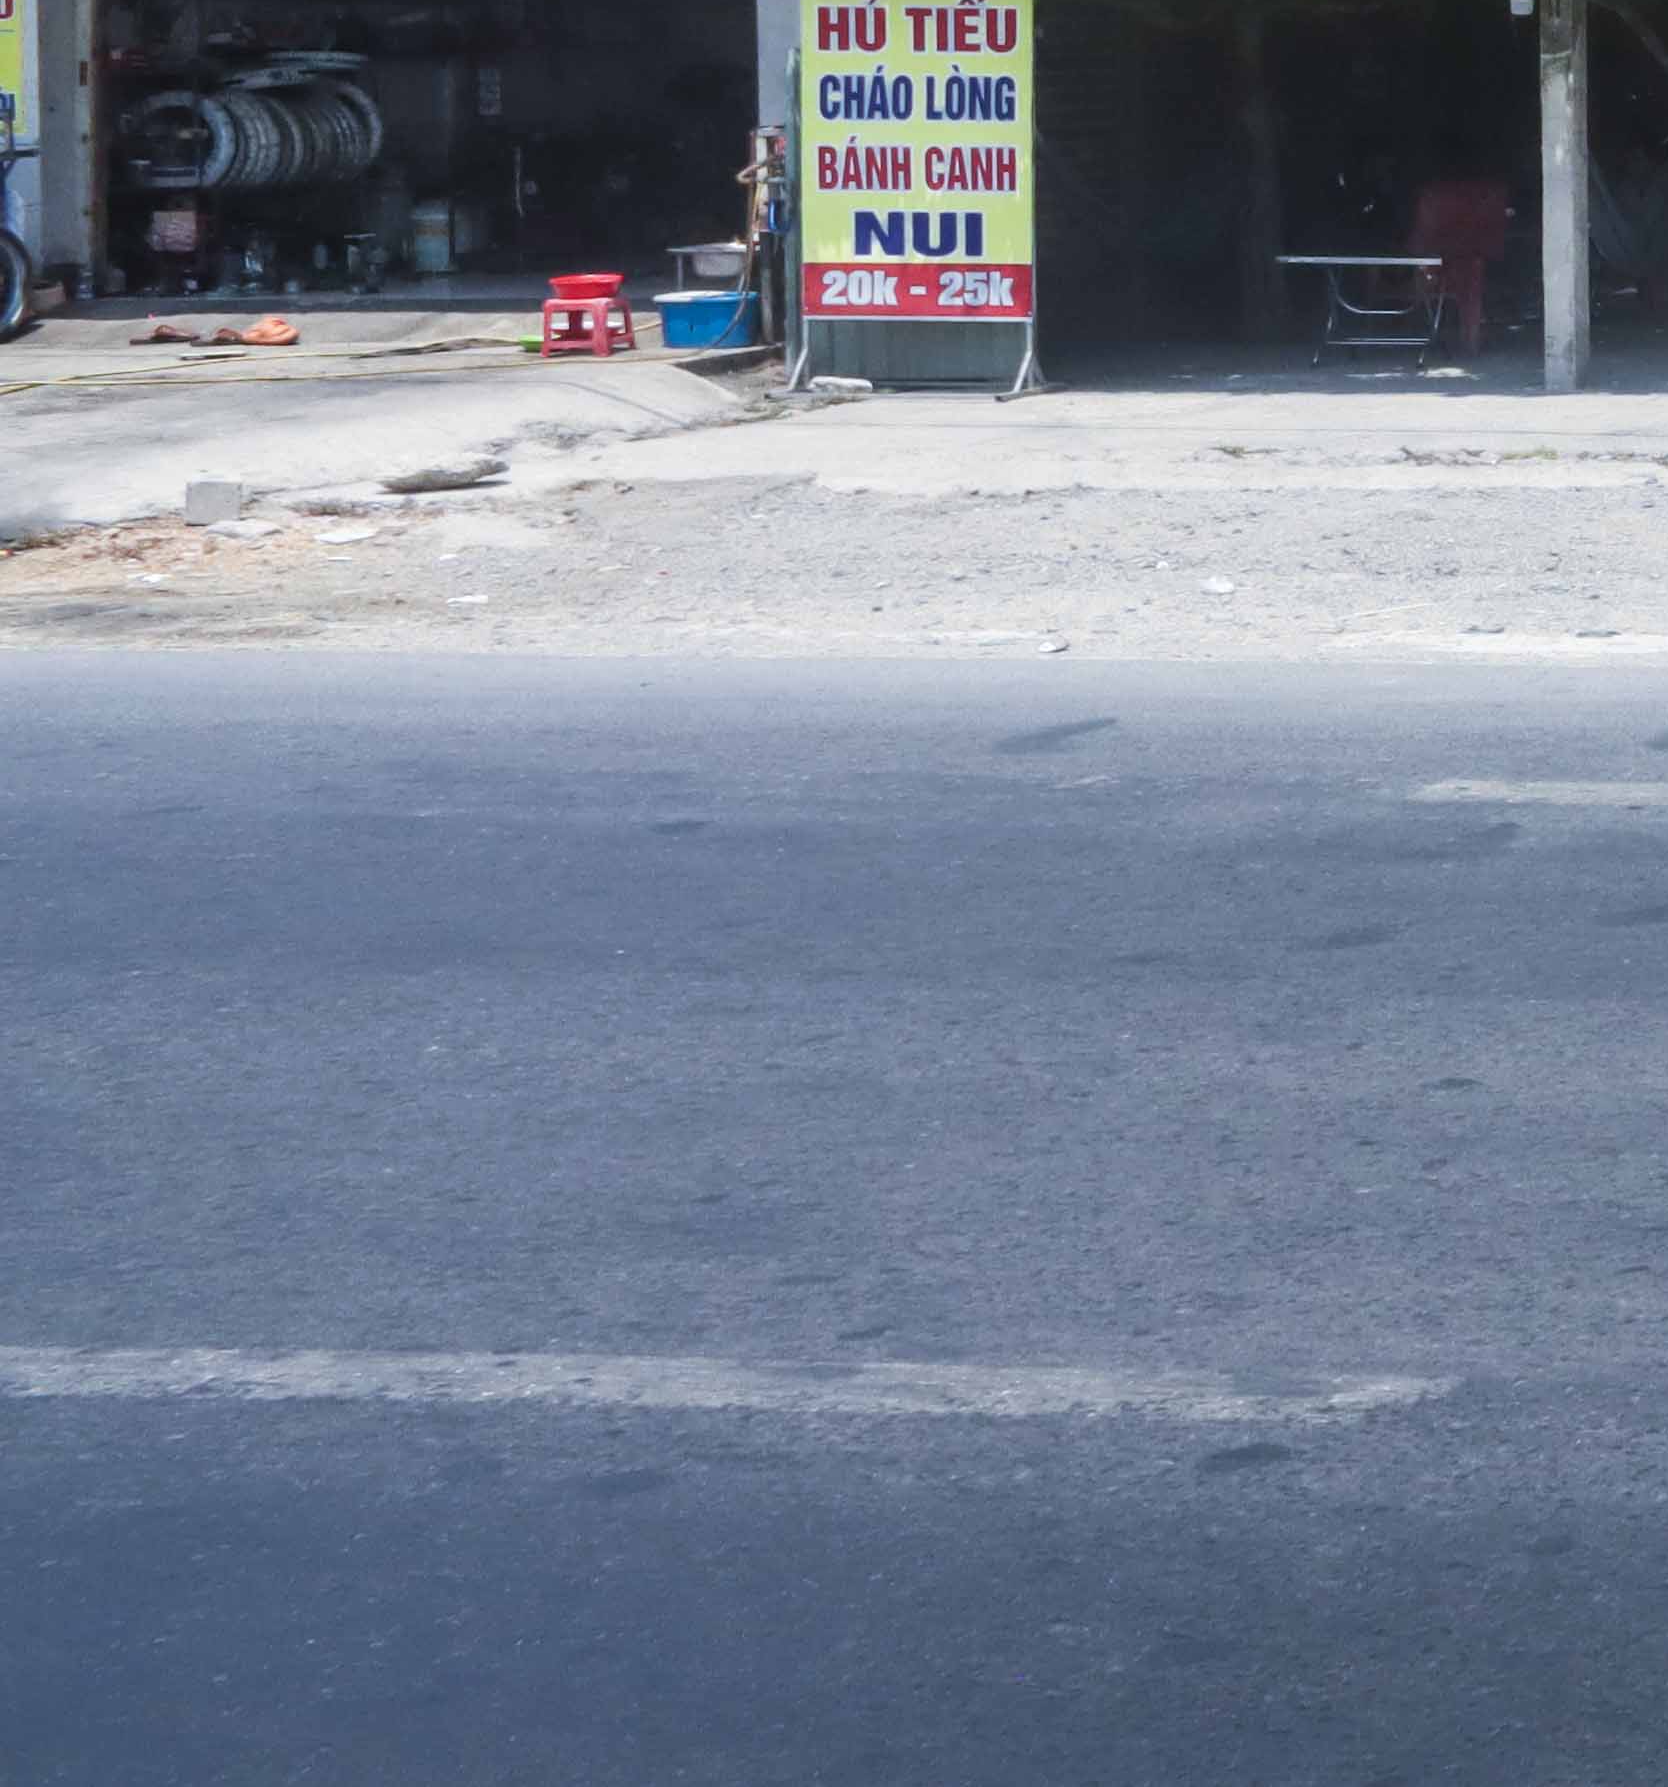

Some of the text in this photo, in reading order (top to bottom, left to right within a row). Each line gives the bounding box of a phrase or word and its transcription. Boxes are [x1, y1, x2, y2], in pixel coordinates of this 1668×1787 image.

[819, 64, 1016, 121] CHÁO LÒNG
[818, 136, 1017, 191] BÁNH CANH
[854, 211, 983, 257] NUI
[821, 270, 898, 306] 20k
[937, 271, 1014, 307] 25k
